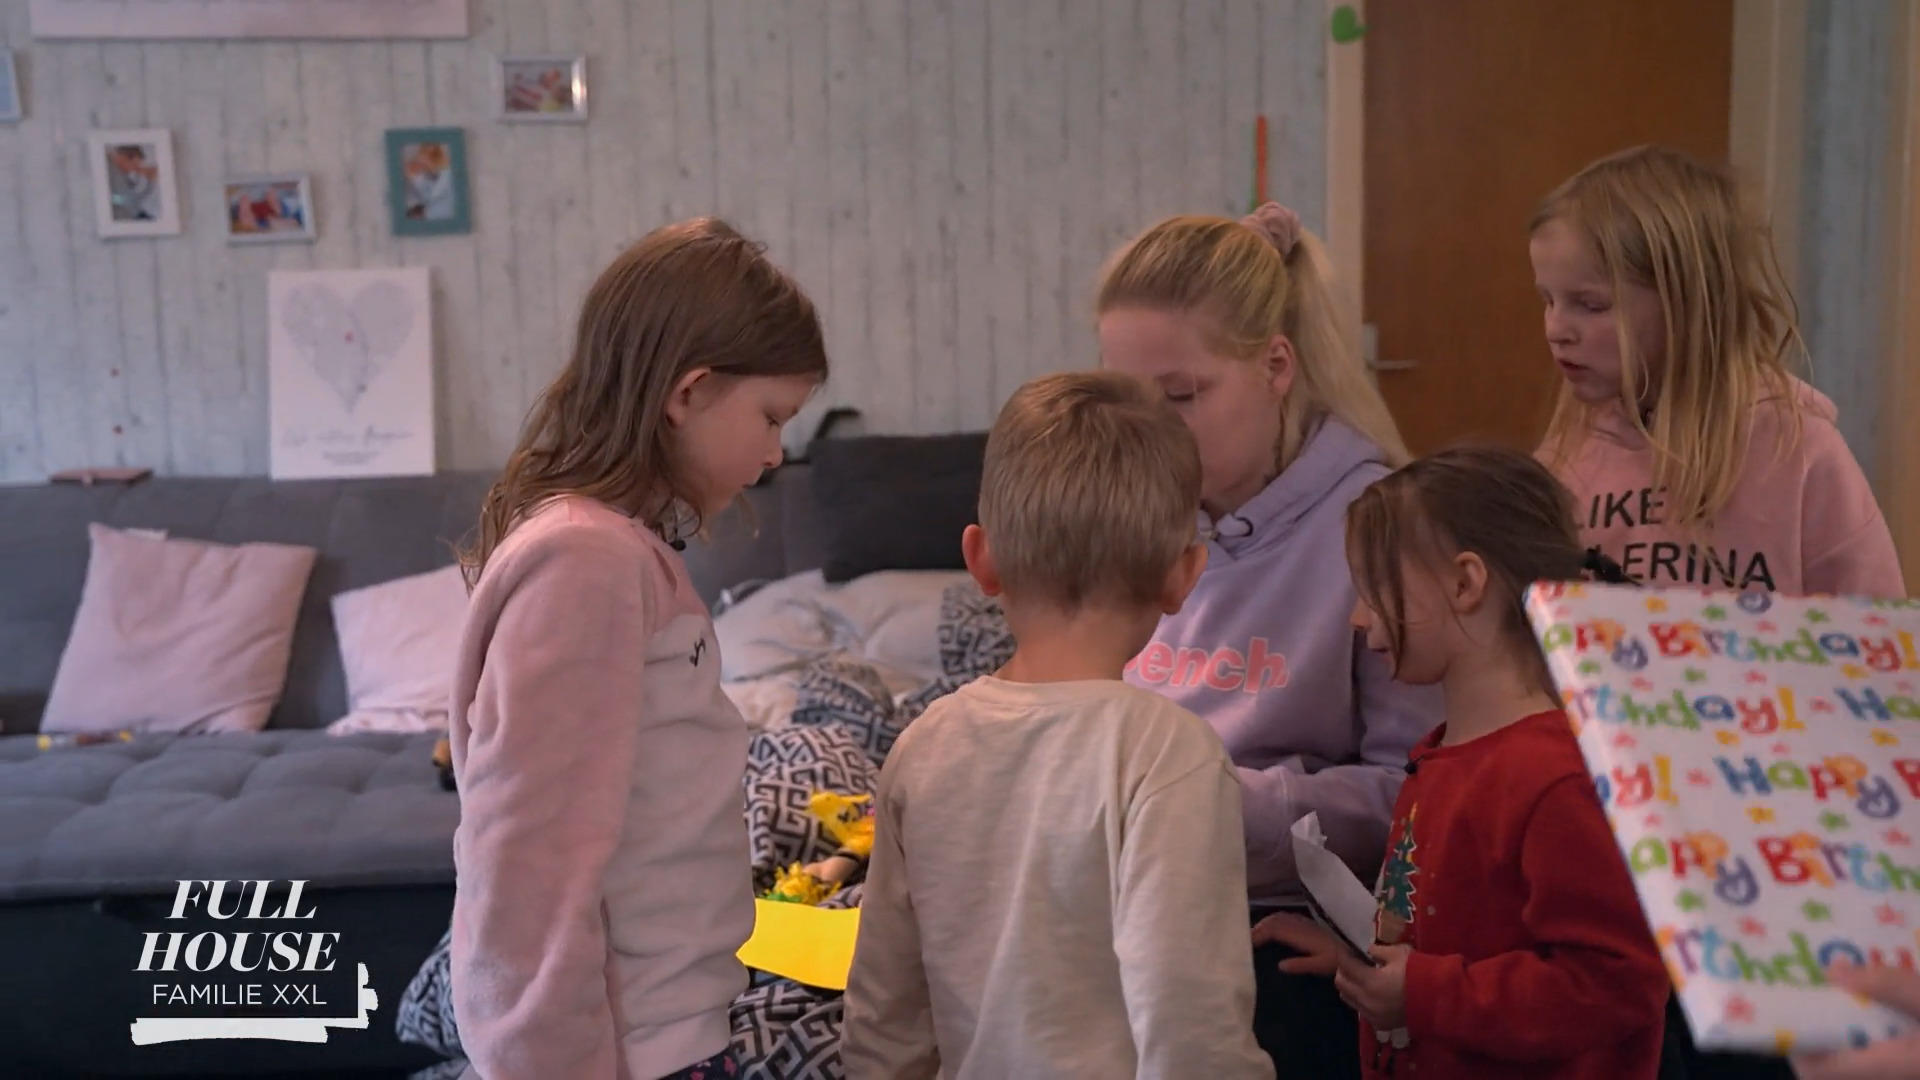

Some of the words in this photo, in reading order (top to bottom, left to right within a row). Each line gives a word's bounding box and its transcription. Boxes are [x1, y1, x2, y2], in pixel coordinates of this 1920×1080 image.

[1580, 486, 1668, 529] IKE
[1616, 541, 1777, 593] ERINA
[1128, 636, 1290, 694] ench
[1544, 619, 1649, 670] appy
[1712, 755, 1902, 820] Happy
[1630, 830, 1760, 906] appy
[1756, 832, 1920, 891] Birth
